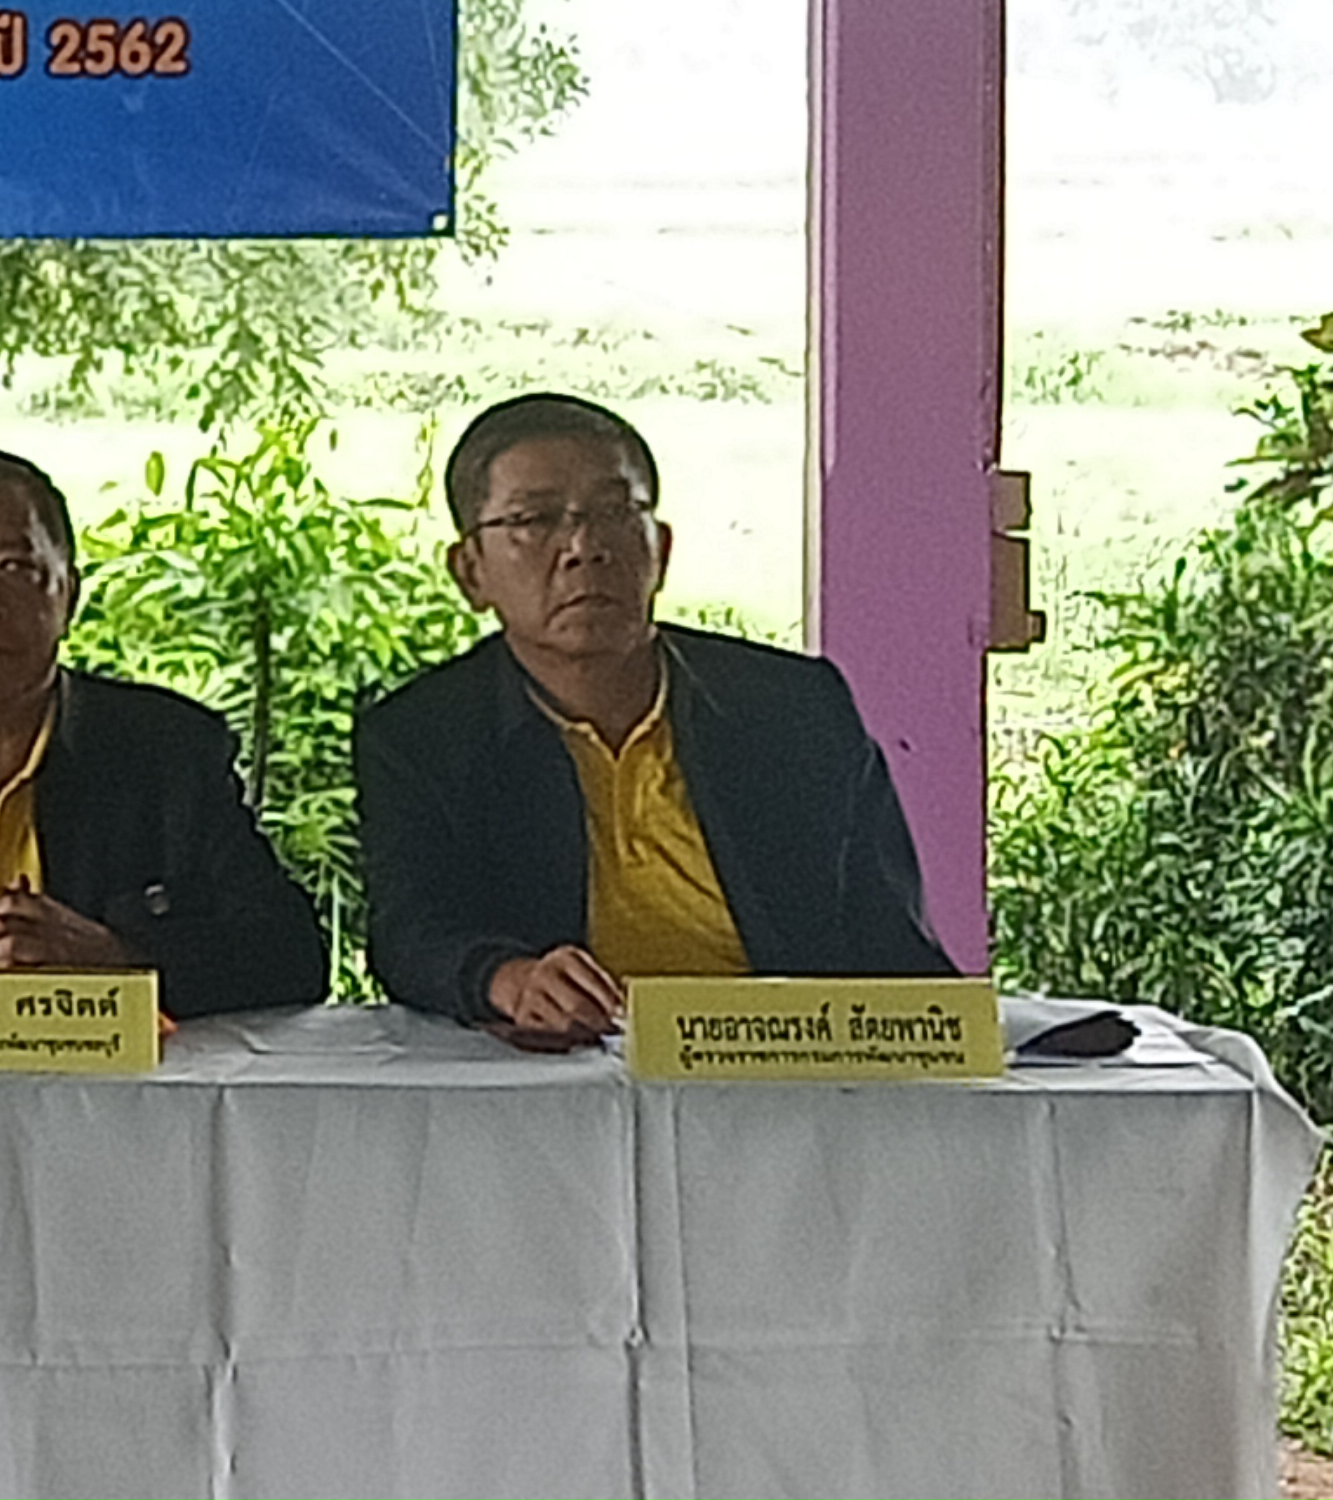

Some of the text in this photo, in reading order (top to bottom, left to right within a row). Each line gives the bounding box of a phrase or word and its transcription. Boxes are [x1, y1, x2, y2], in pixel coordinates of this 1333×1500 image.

[48, 18, 193, 78] 2562
[676, 1000, 835, 1043] นายอาจณรงค์
